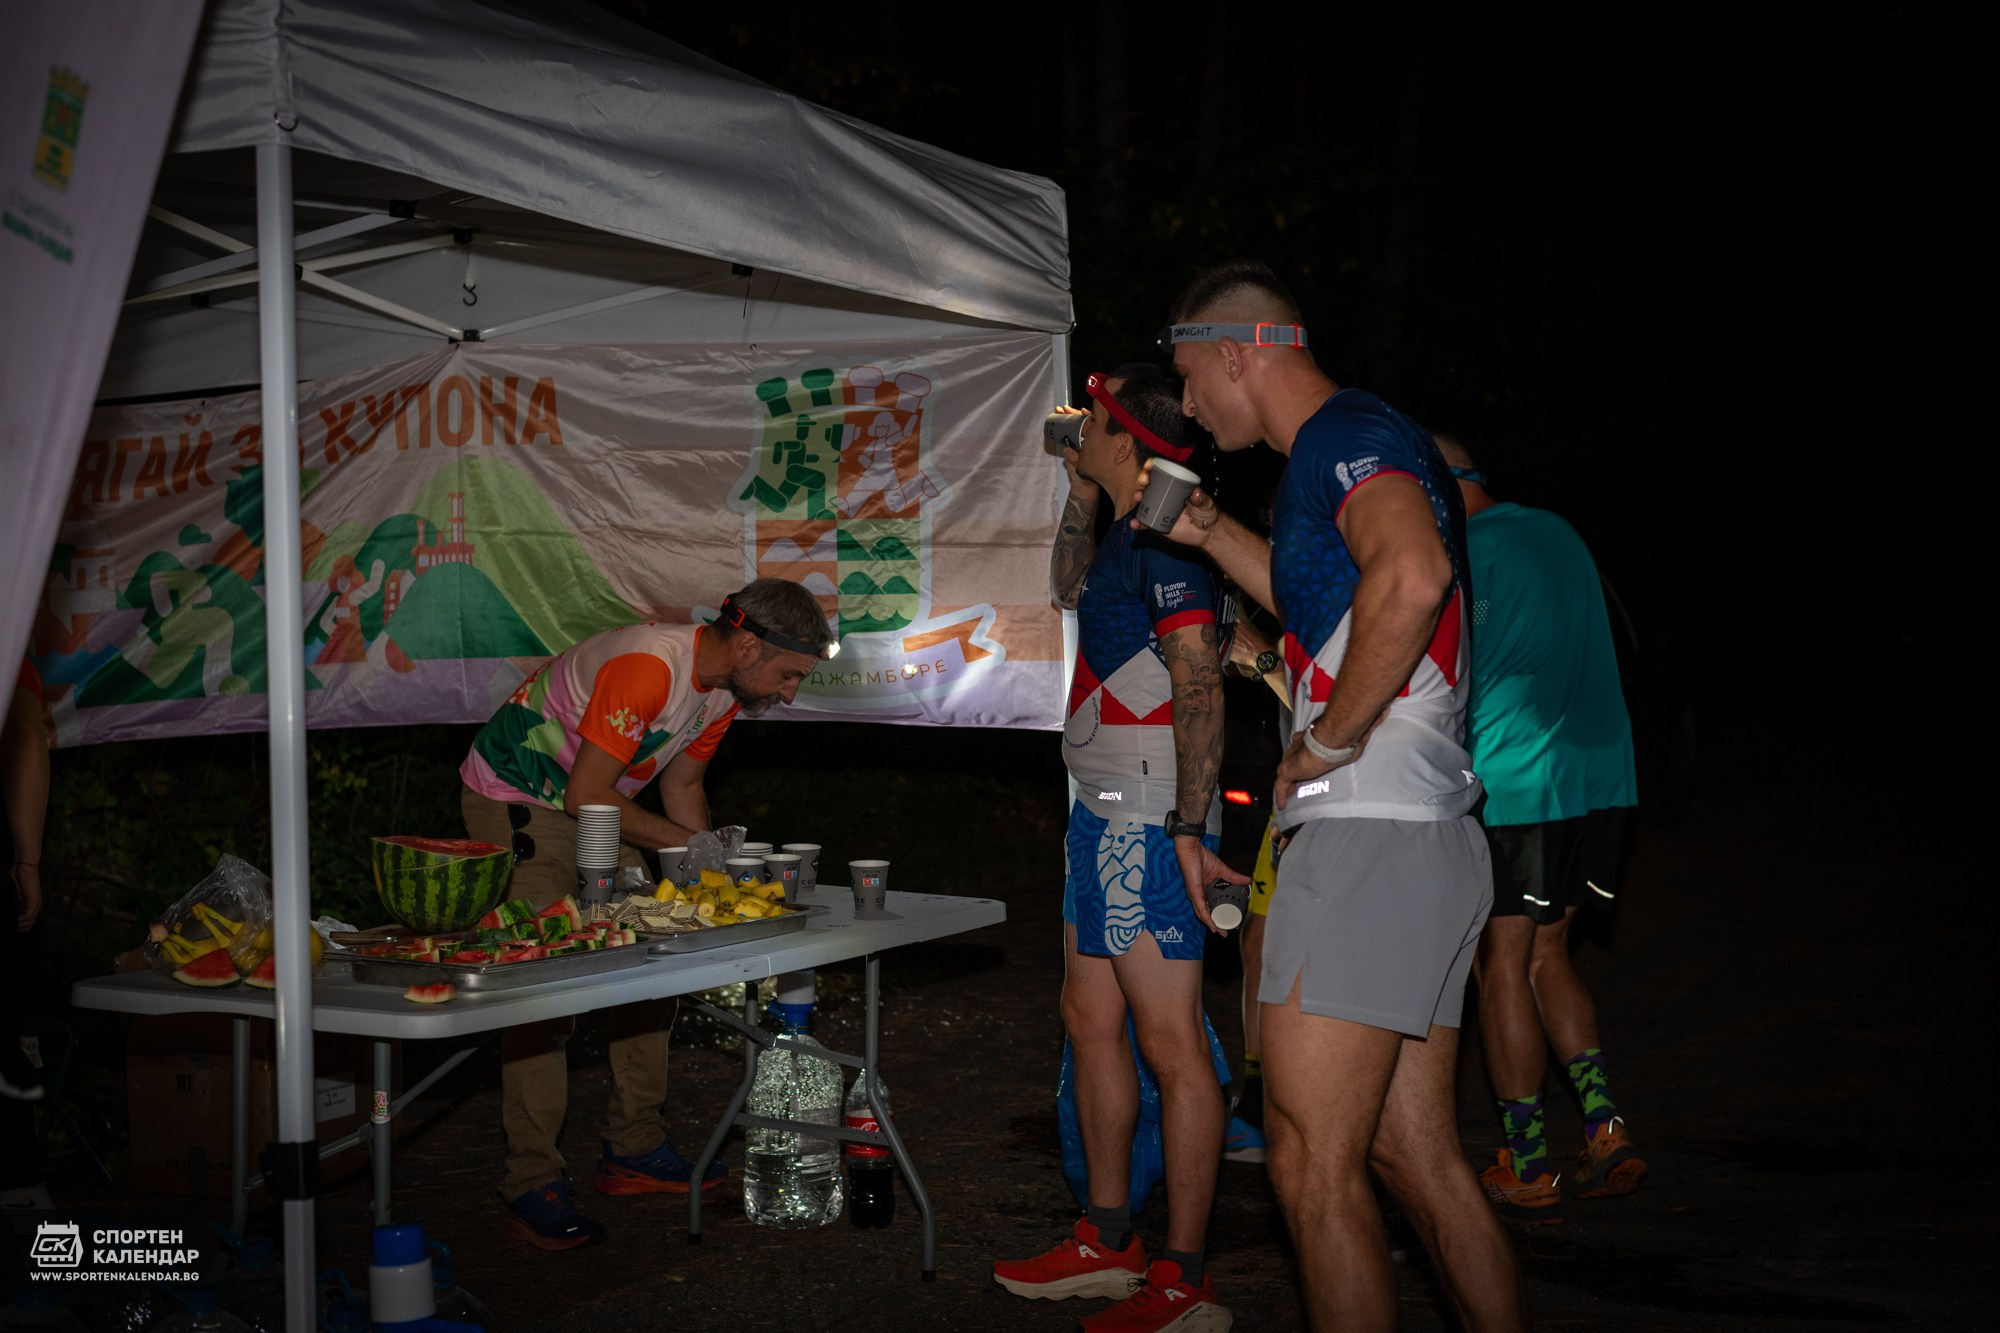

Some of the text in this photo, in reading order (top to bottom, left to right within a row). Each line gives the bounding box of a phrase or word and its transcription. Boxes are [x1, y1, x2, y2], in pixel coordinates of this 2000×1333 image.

[72, 413, 215, 504] ЯГАЙ
[1163, 581, 1187, 593] PLOVDIV
[811, 659, 947, 686] ДЖАМБОРЕ
